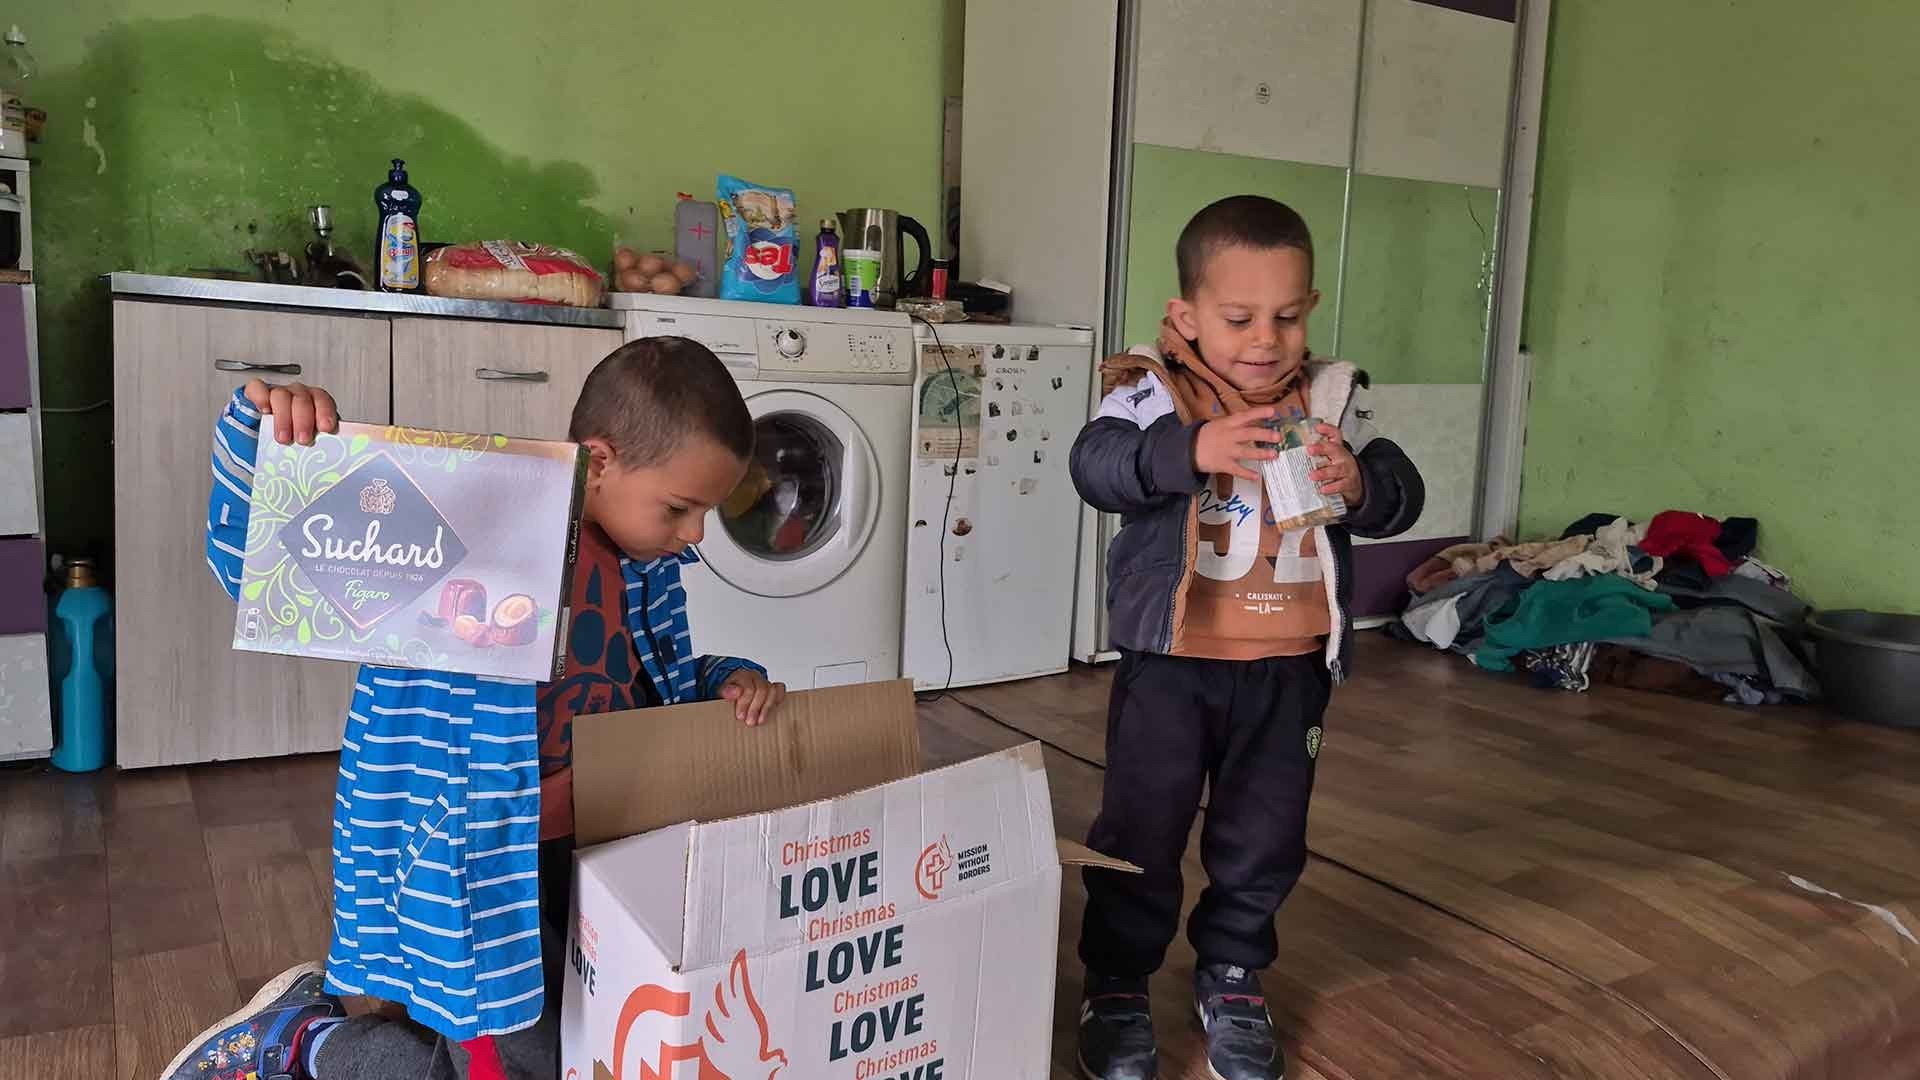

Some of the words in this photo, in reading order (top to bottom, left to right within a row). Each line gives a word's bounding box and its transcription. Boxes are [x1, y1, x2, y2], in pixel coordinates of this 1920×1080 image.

[302, 513, 443, 569] Suchard
[327, 565, 371, 577] CHOCOLAT
[344, 579, 391, 610] Figaro
[1258, 602, 1271, 614] LA
[782, 827, 872, 866] Christmas
[957, 844, 988, 860] MISSION
[958, 854, 990, 870] WITHOUT
[780, 851, 878, 919] LOVE
[958, 865, 991, 881] BORDERS
[808, 902, 896, 942] Christmas
[571, 936, 596, 997] LOVE
[805, 924, 904, 992] LOVE
[833, 973, 919, 1014] Christmas
[829, 993, 925, 1062] LOVE
[855, 1039, 937, 1080] Christmas
